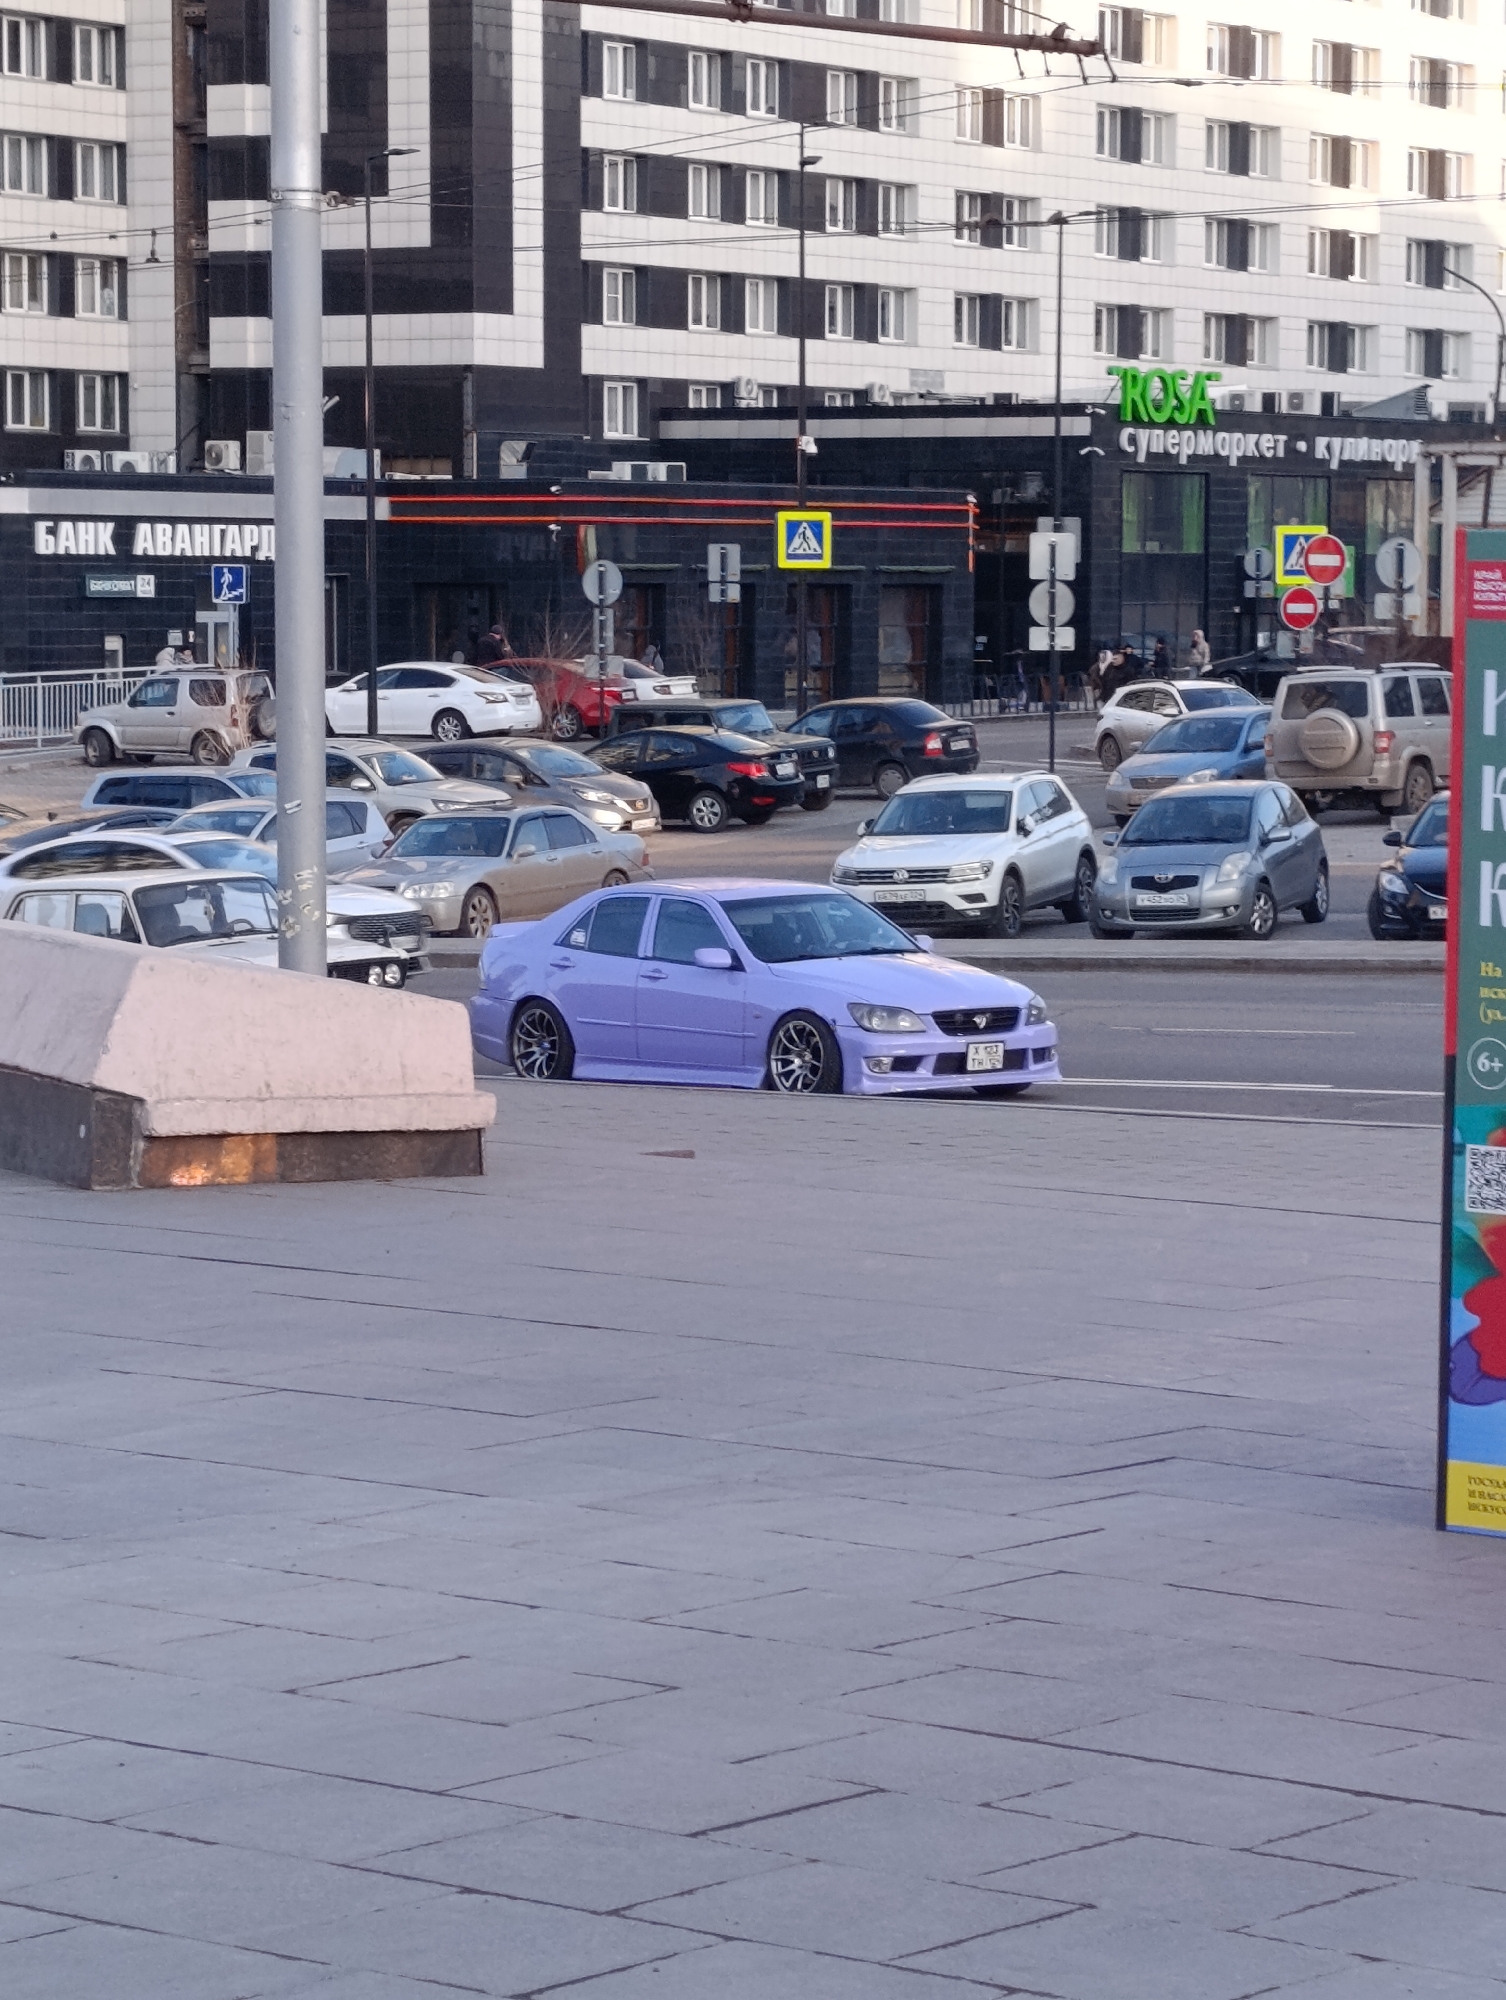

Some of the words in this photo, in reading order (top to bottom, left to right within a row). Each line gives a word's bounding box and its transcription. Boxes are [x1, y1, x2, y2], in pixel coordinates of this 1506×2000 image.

[1119, 427, 1288, 466] супермаркет
[34, 521, 117, 555] БАНК
[132, 523, 275, 561] АВАНГАРД
[1477, 1052, 1504, 1073] 6+
